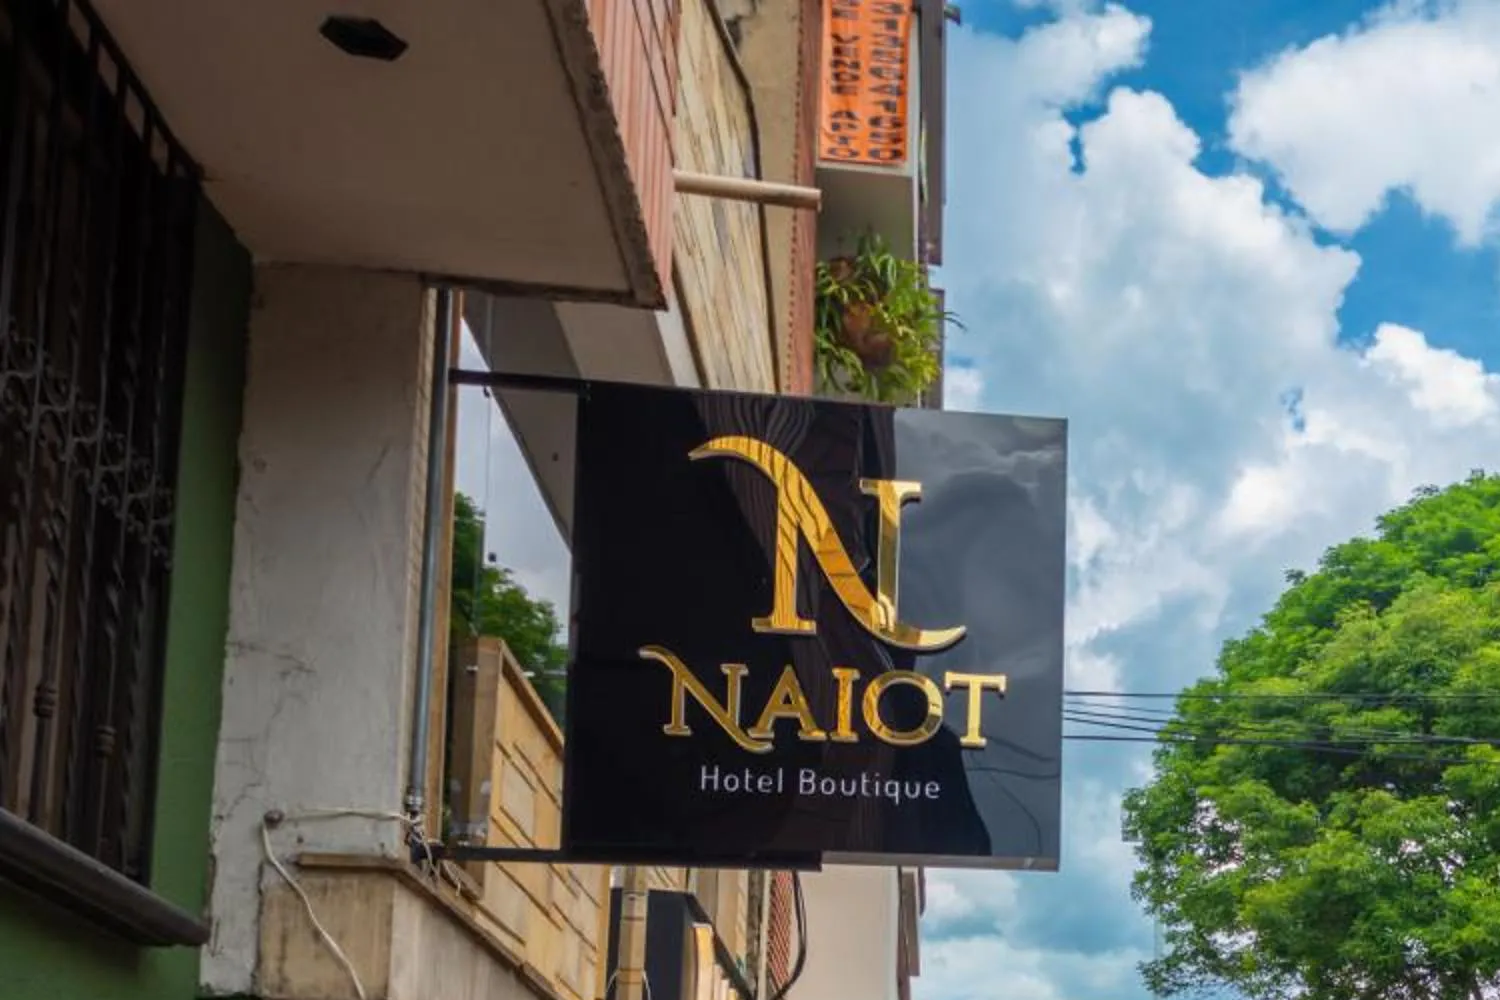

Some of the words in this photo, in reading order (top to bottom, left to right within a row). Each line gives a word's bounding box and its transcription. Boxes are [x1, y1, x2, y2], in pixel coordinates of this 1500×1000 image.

[830, 32, 861, 95] VENDE
[637, 645, 1007, 753] NAIOT
[699, 765, 784, 794] Hotel
[799, 769, 941, 805] Boutique
